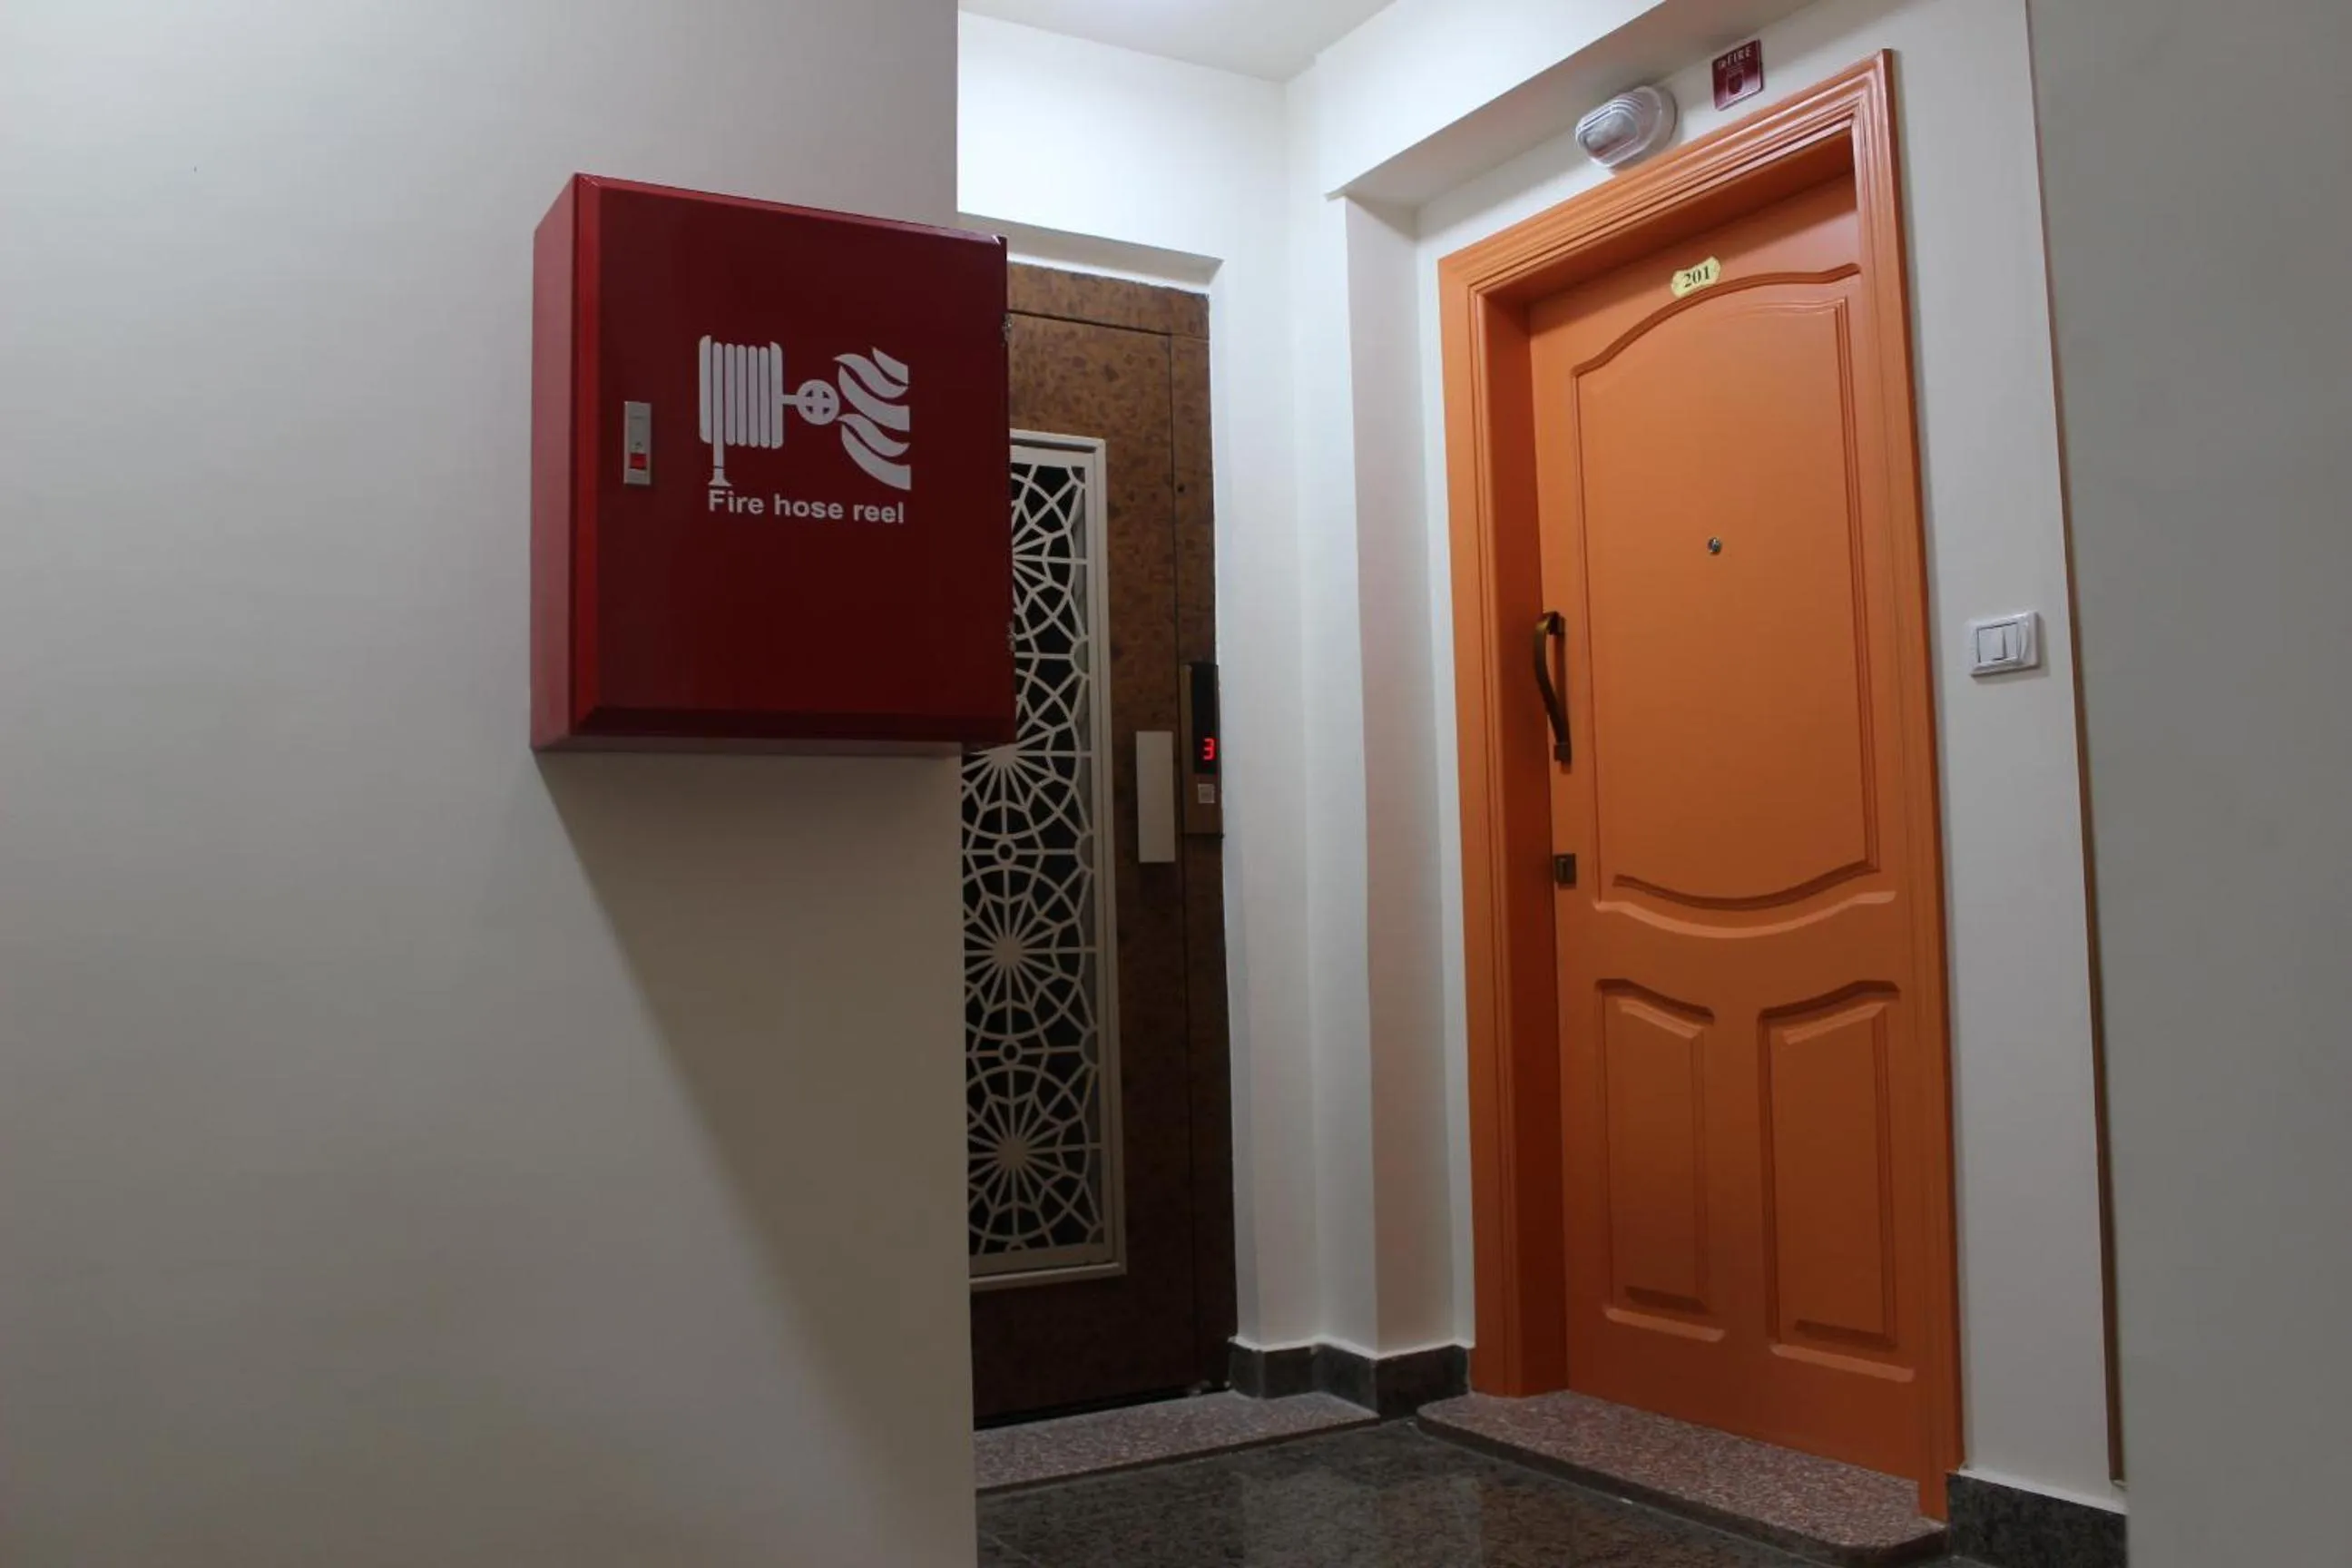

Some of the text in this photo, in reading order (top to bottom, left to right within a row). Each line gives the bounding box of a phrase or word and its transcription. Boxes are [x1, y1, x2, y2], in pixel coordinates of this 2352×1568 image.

[1727, 46, 1751, 65] FIRE
[1684, 266, 1710, 288] 201
[709, 489, 904, 524] Fire hose reel
[1203, 738, 1215, 760] 3
